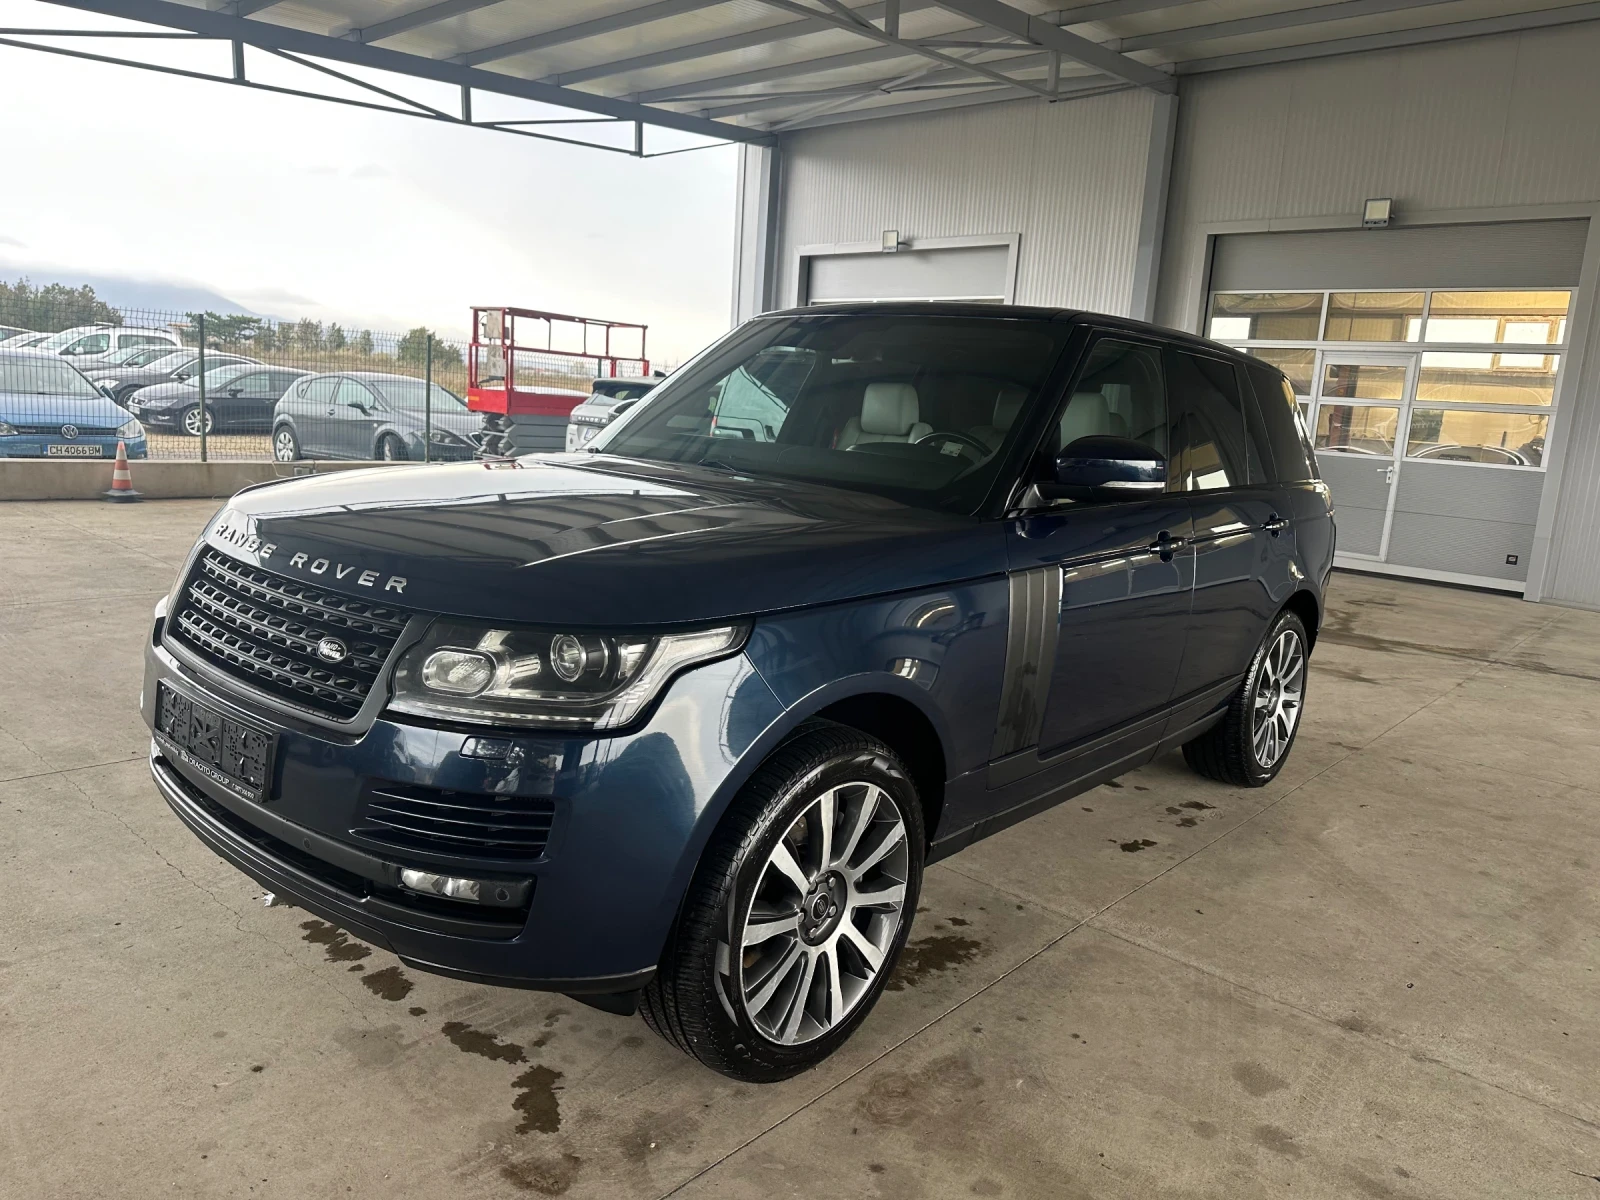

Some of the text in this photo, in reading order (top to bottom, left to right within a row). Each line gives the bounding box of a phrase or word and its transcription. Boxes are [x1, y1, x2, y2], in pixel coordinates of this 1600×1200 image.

[49, 446, 101, 455] CH 4066 BM
[215, 523, 408, 594] RANGE ROVER
